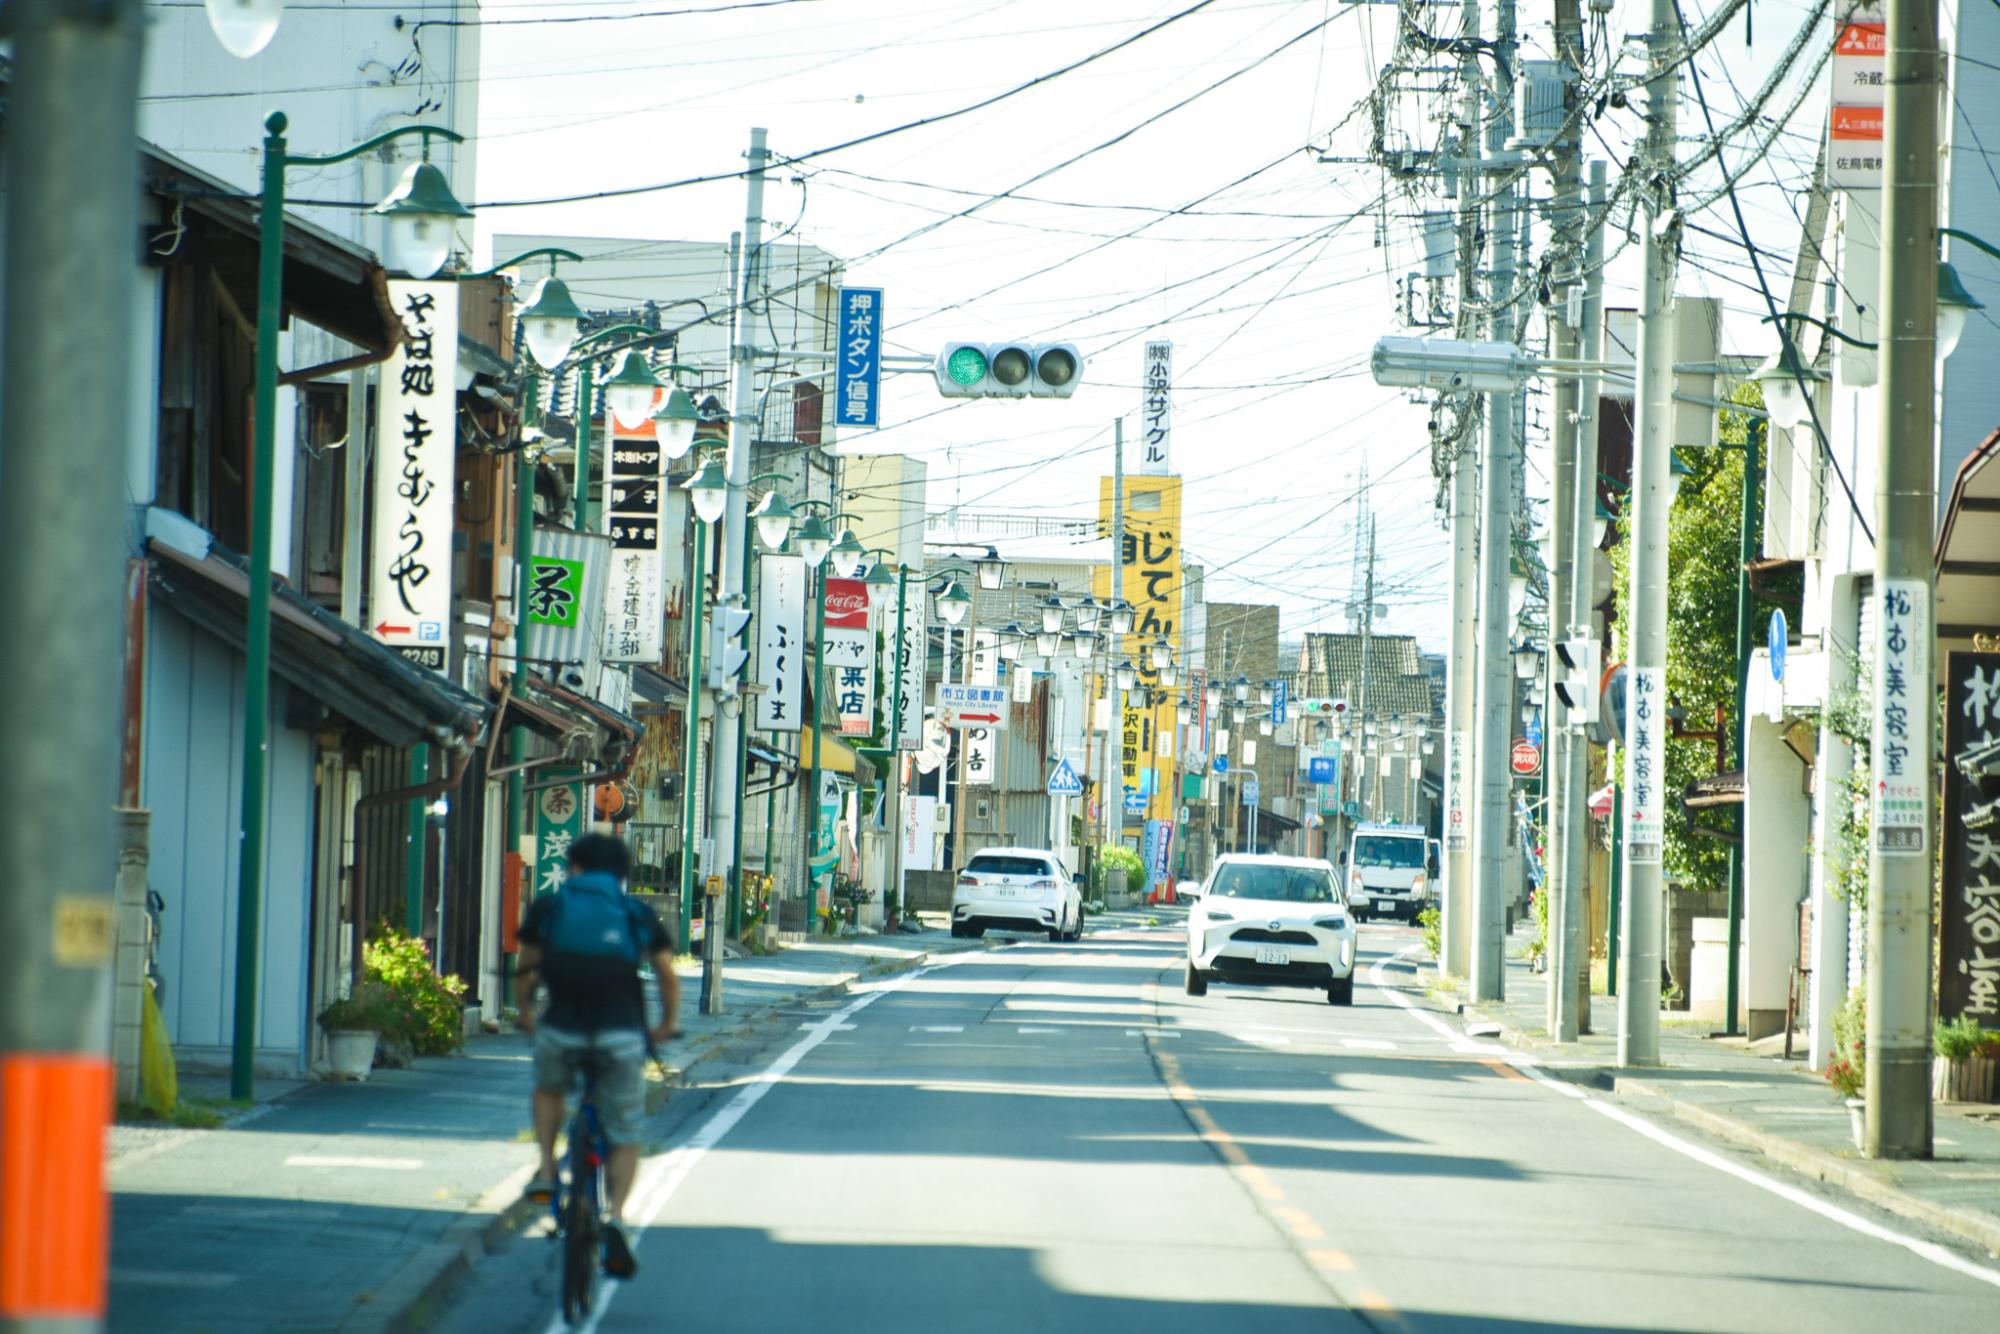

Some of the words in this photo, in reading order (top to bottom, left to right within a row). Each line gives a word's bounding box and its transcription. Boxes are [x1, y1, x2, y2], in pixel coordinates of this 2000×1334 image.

[846, 294, 873, 423] 押ボタン信号
[824, 594, 864, 608] Coca-Cola
[768, 624, 795, 720] ふくしま
